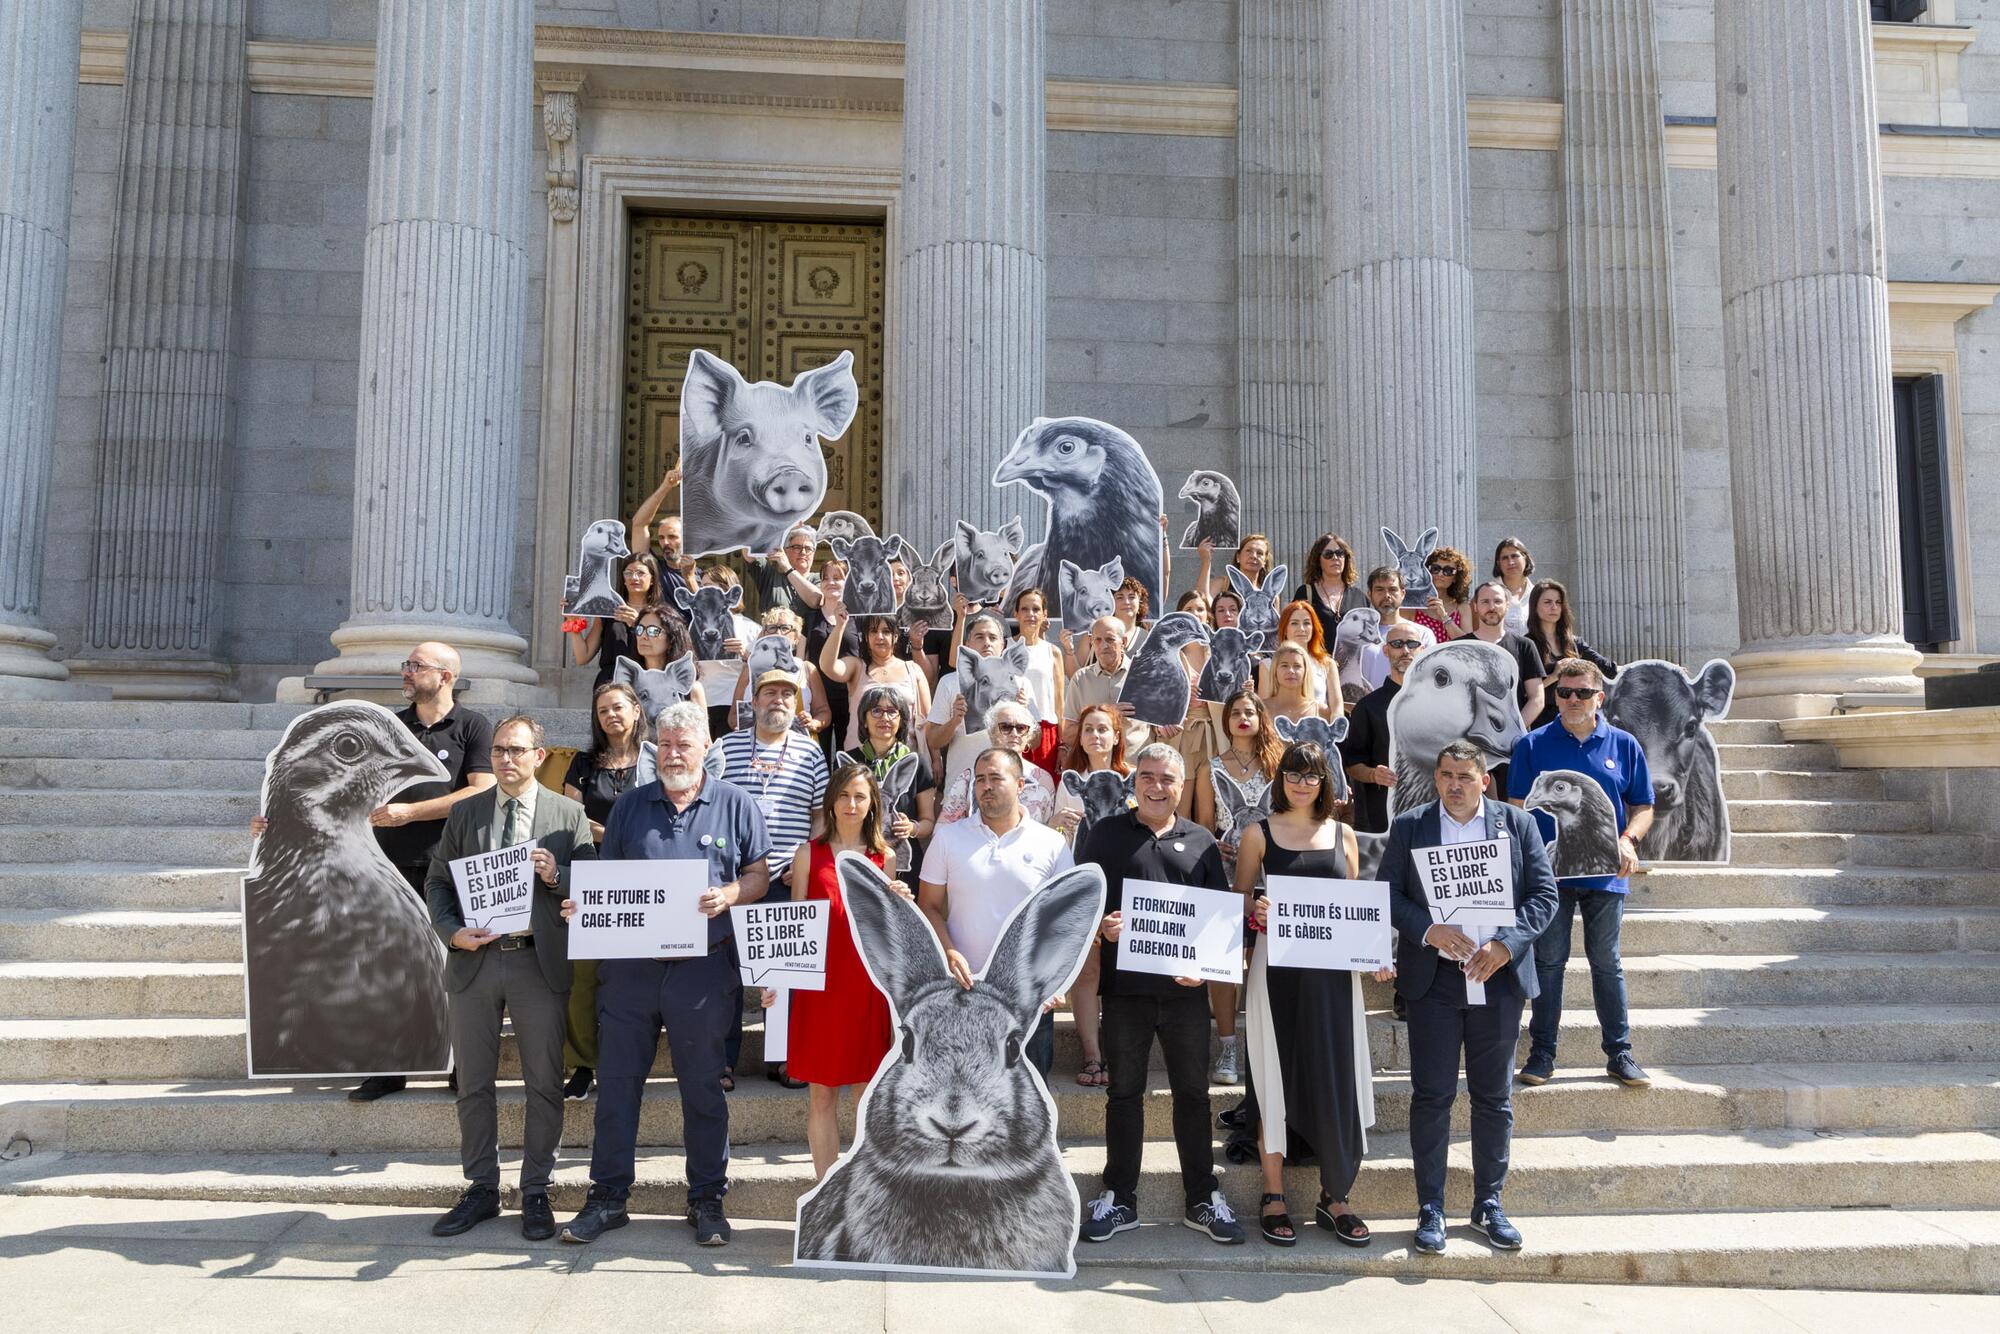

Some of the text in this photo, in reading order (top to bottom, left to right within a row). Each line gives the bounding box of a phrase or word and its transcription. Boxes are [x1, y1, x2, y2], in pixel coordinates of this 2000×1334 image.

[465, 847, 528, 876] EL FUTURO
[1428, 844, 1498, 865] EL FUTURO
[468, 867, 519, 894] ES LIBRE
[1431, 863, 1489, 882] ES LIBRE
[470, 882, 528, 911] DE JAULAS
[582, 889, 665, 905] THE FUTURE IS
[1434, 878, 1504, 900] DE JAULAS
[746, 905, 817, 924] EL FUTURO
[1132, 896, 1196, 918] ETORKIZUNA
[1278, 901, 1380, 922] EL FUTUR ÉS LLIURE
[582, 912, 645, 928] CAGE-FREE
[1131, 918, 1186, 938] KAIOLARIK
[1278, 920, 1332, 940] DE GÀBIES
[747, 924, 804, 942] ES LIBRE
[748, 941, 817, 960] DE JAULAS
[1129, 940, 1196, 960] GABEKOA DA
[1112, 1213, 1125, 1227] N
[1198, 1211, 1213, 1227] N
